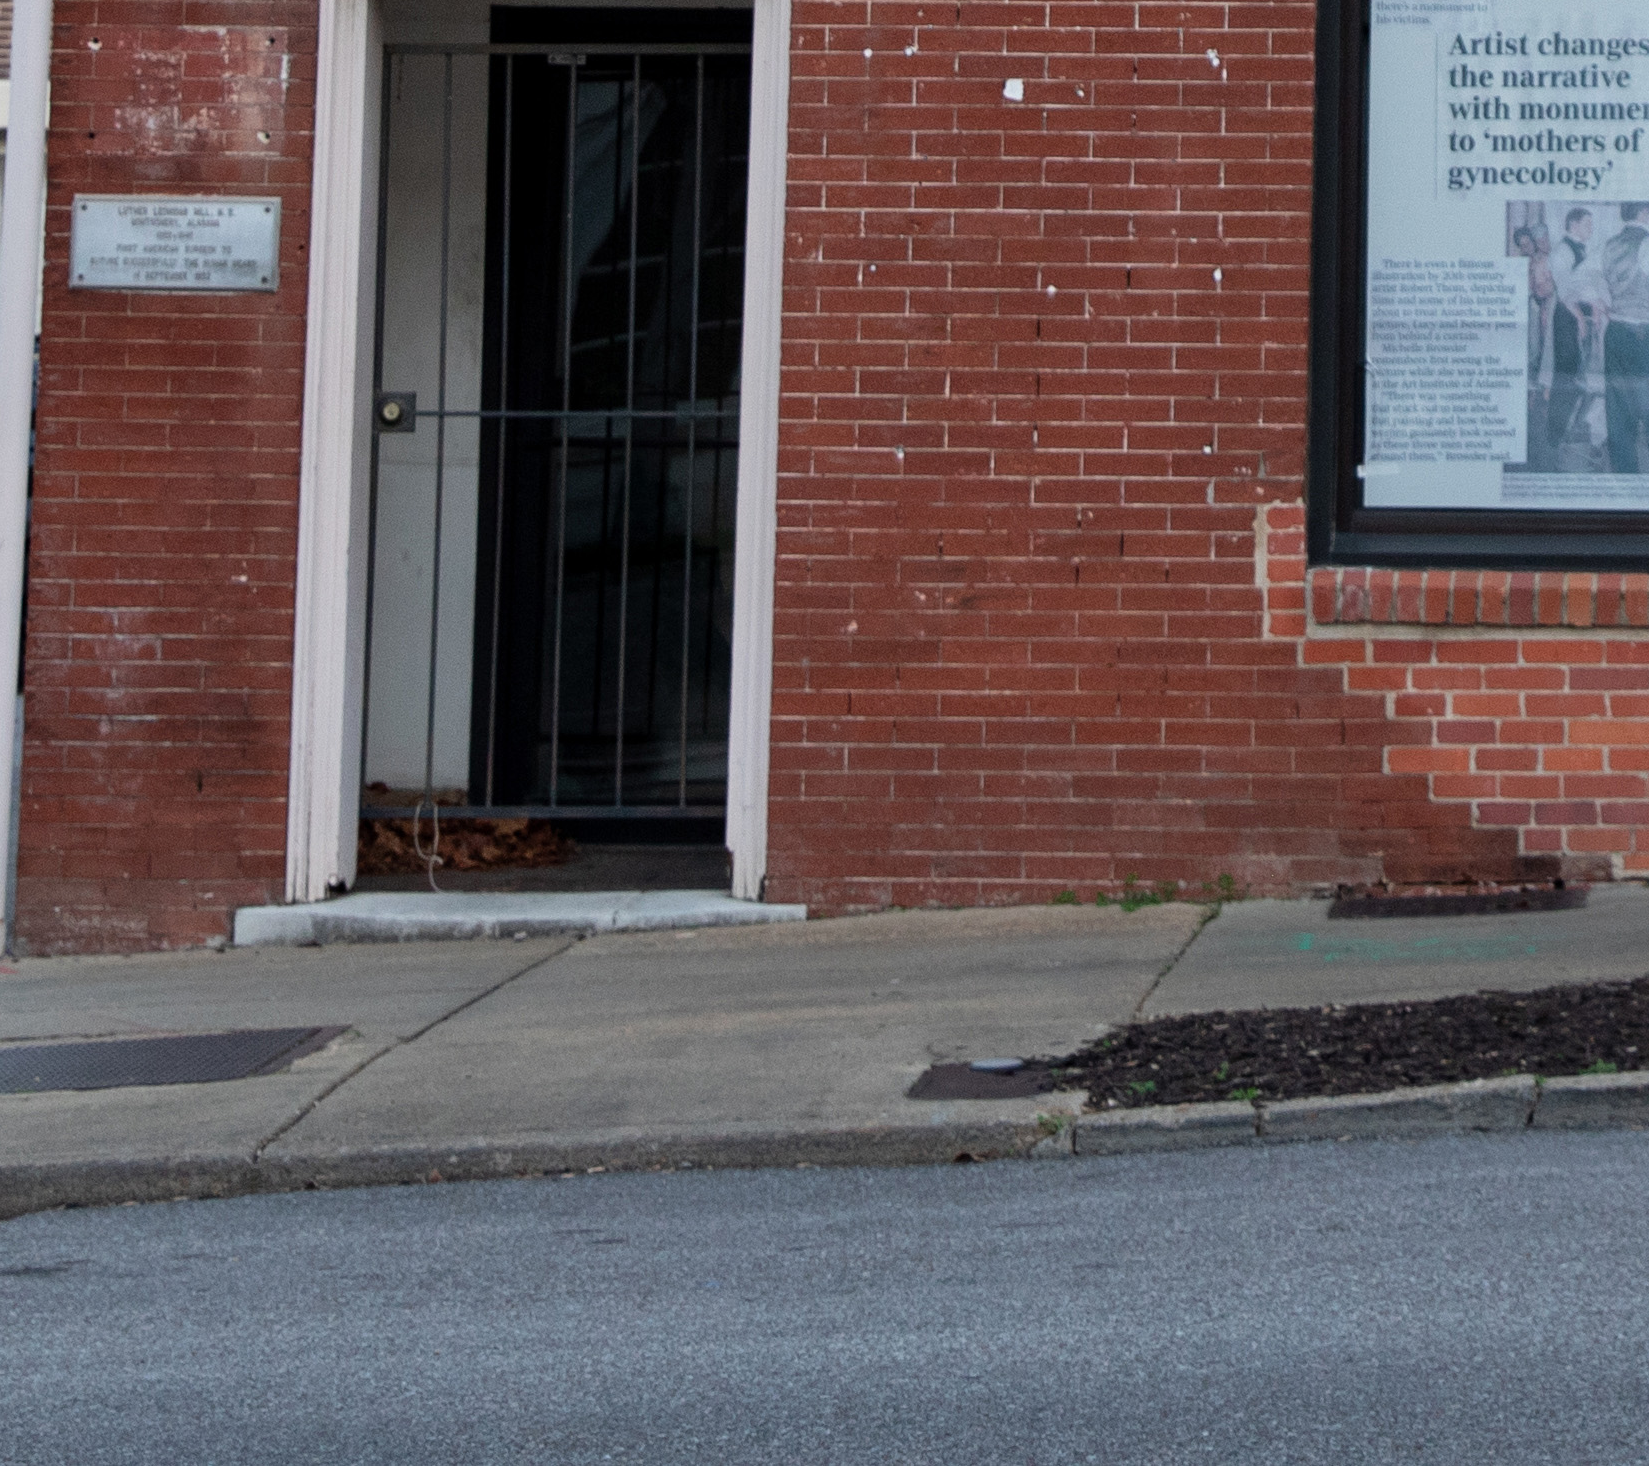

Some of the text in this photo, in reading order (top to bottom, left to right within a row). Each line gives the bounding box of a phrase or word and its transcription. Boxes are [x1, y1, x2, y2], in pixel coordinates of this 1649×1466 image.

[1449, 32, 1529, 56] Artist
[1449, 64, 1631, 88] the narrative
[1449, 96, 1511, 120] with
[1449, 131, 1476, 152] to
[1613, 127, 1645, 152] of
